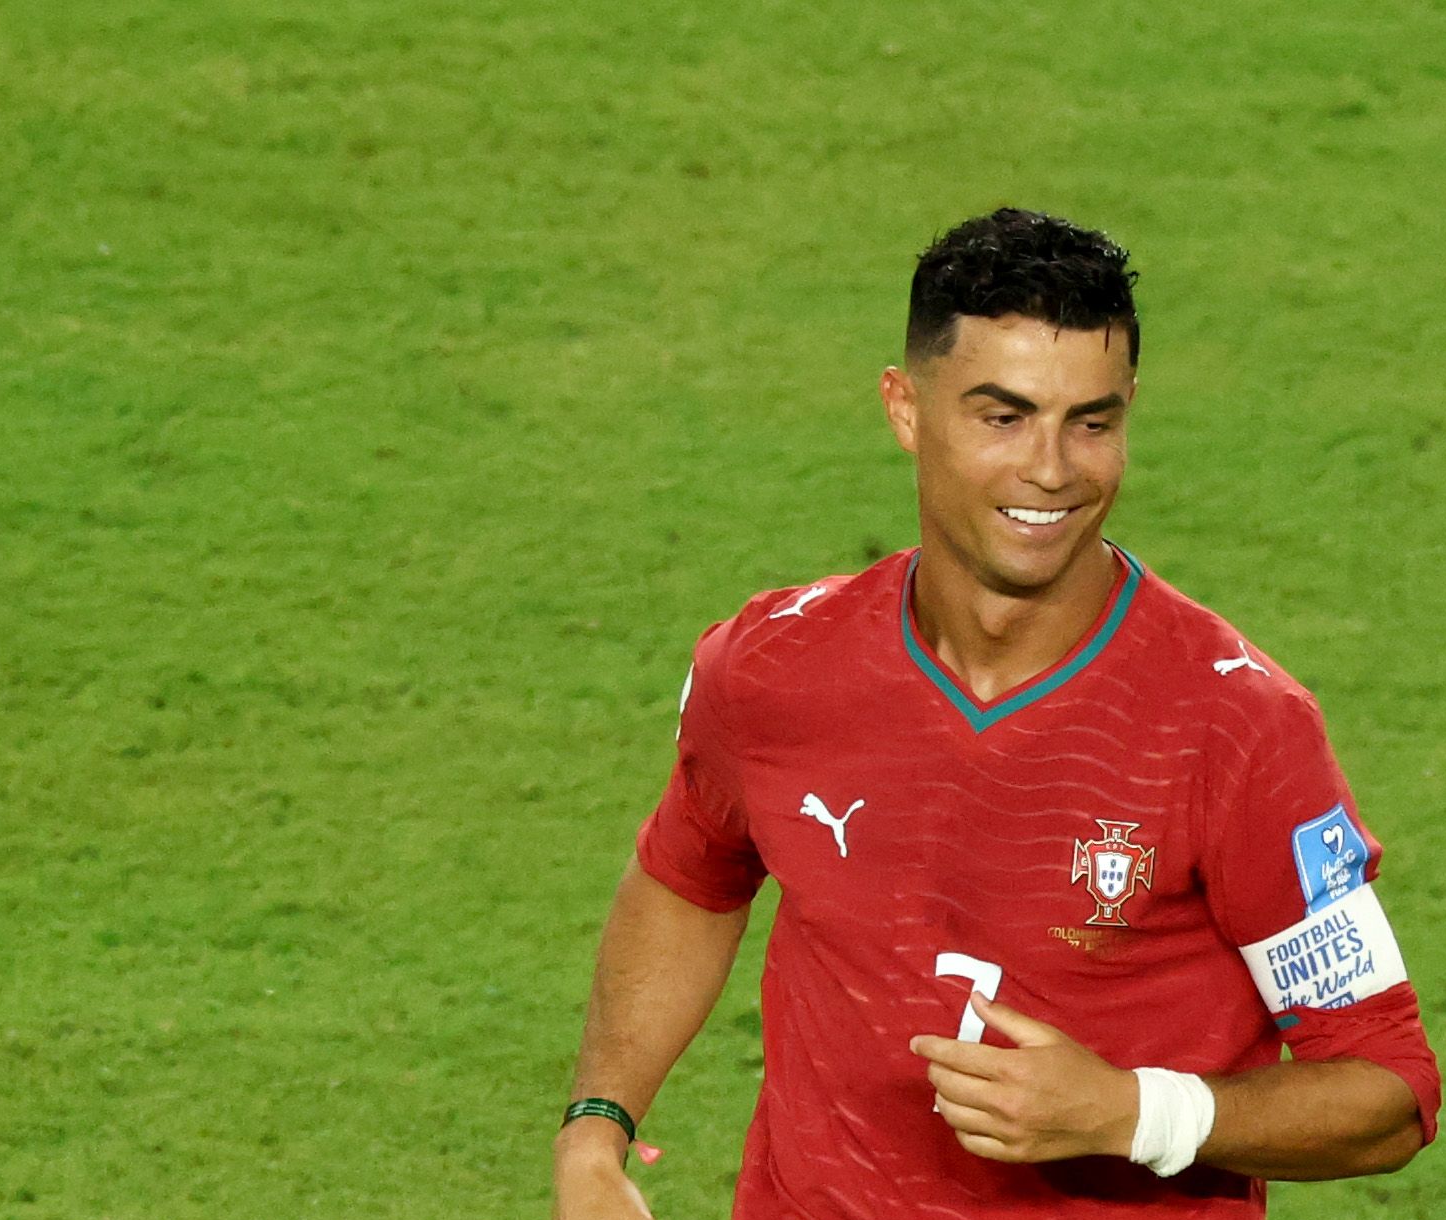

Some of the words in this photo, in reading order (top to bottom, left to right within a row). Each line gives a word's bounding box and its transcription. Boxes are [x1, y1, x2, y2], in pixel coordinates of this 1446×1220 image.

[1266, 909, 1355, 966] FOOTBALL
[1272, 927, 1364, 991] UNITES
[934, 951, 1003, 1045] 7
[1279, 991, 1312, 1010] the
[1312, 949, 1375, 1000] World
